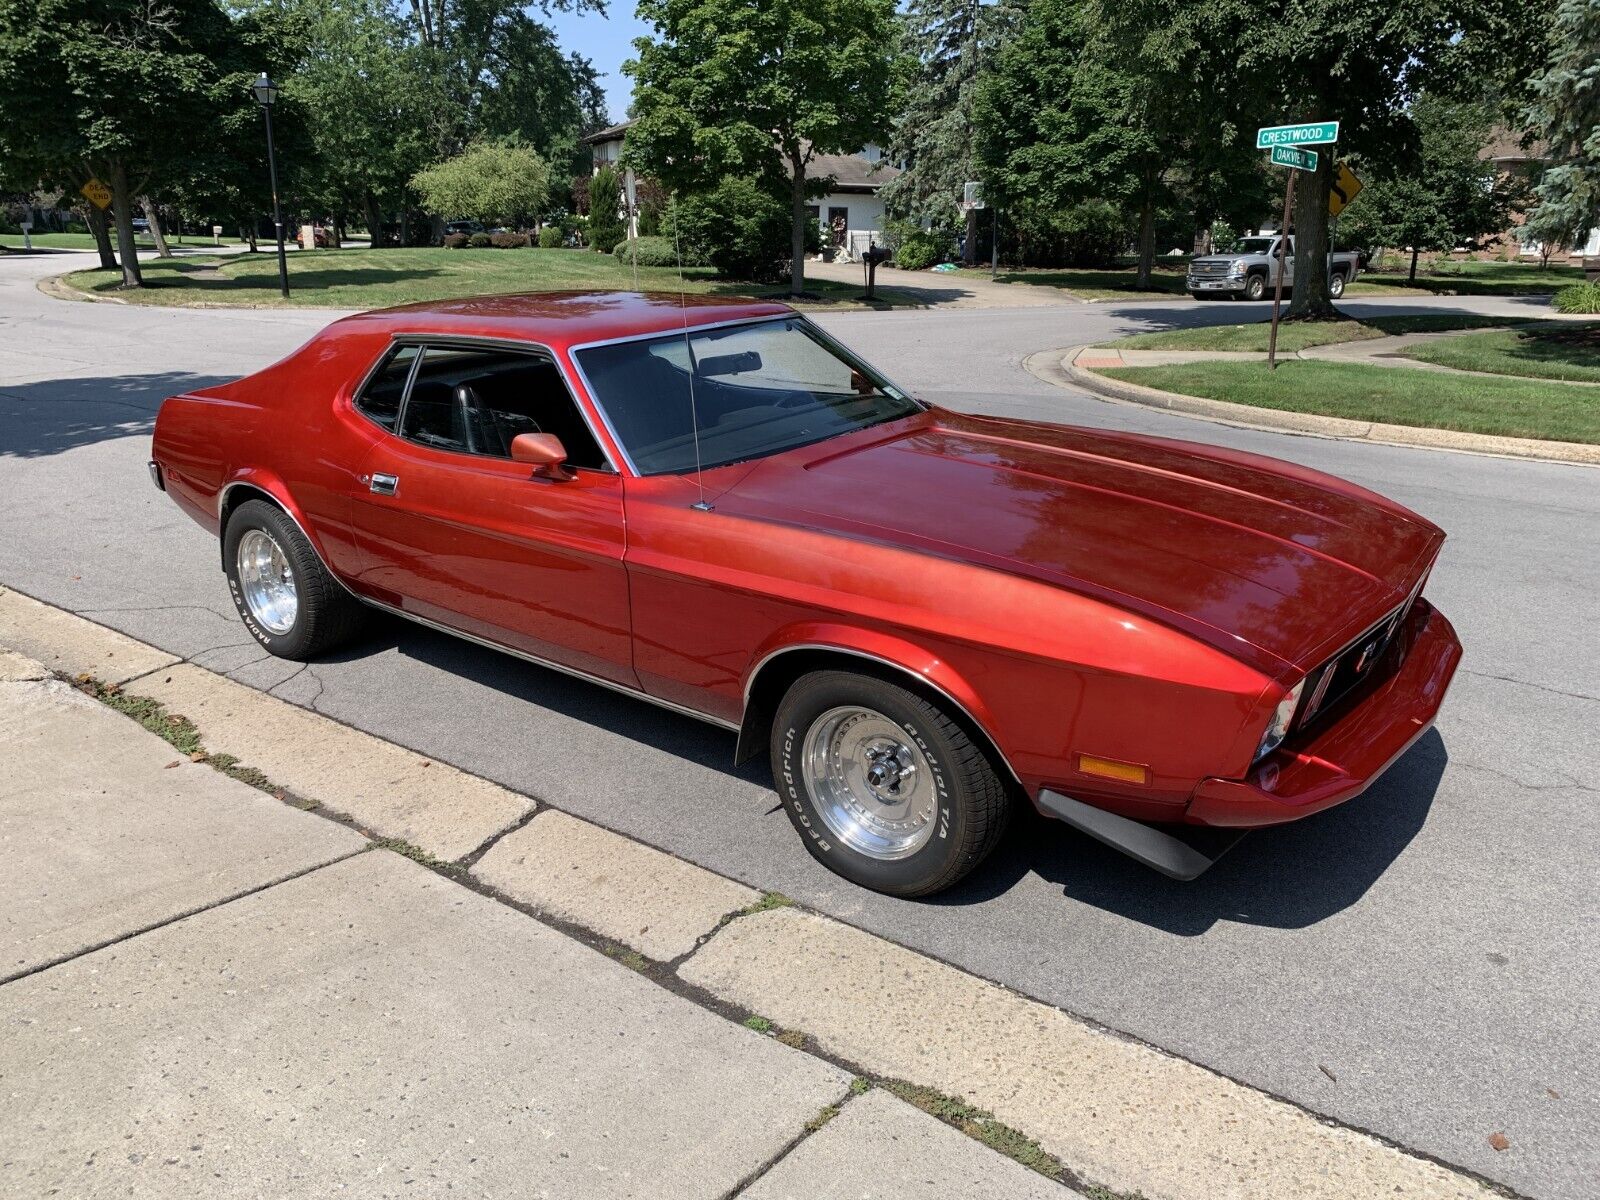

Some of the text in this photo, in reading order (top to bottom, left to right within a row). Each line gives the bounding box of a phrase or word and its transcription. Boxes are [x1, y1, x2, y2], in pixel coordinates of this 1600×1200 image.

[1262, 128, 1322, 143] CRESTWOOD
[1277, 149, 1306, 165] OAKVIEW
[242, 610, 271, 644] RADIAL
[782, 727, 832, 852] BFGoodrich
[903, 722, 950, 839] Radial T/A
